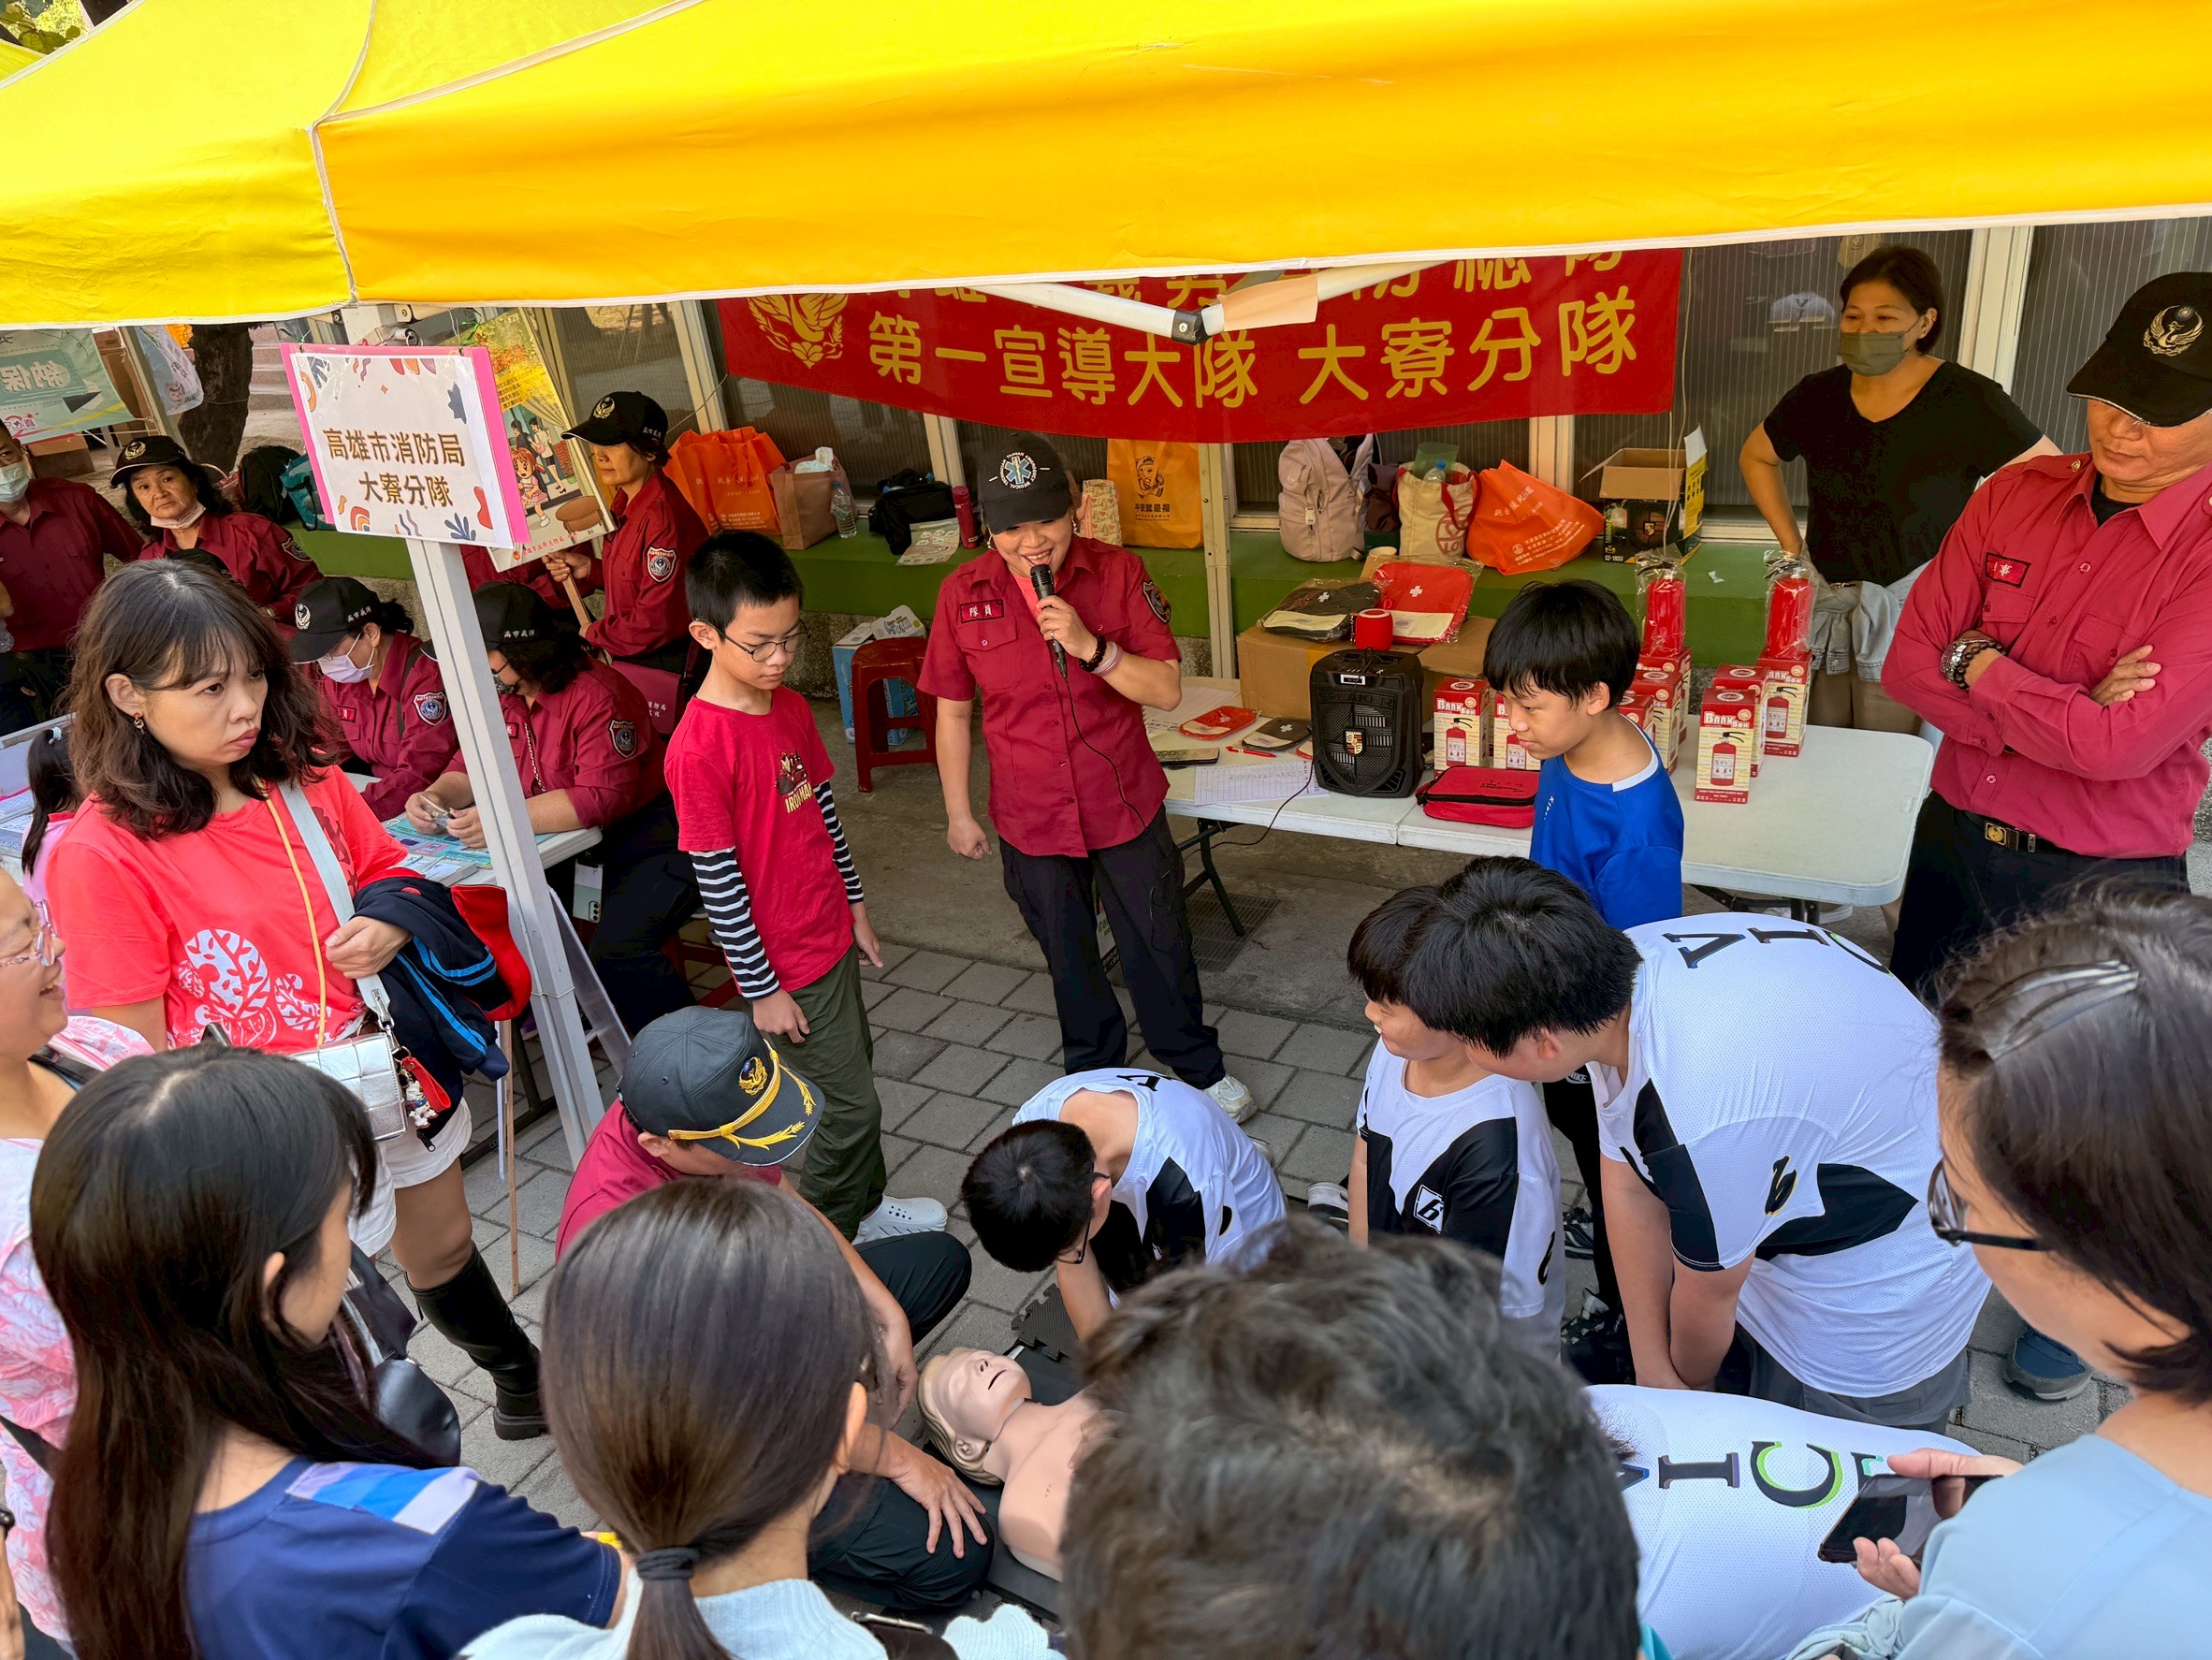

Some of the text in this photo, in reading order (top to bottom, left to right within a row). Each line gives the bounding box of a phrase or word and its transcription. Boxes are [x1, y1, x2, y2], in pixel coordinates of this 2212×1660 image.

[868, 285, 1638, 408] 第一宣導大隊 大寮分隊
[323, 428, 465, 467] 高雄市消防局
[358, 471, 454, 507] 大寮分隊
[1704, 711, 1735, 725] BANK
